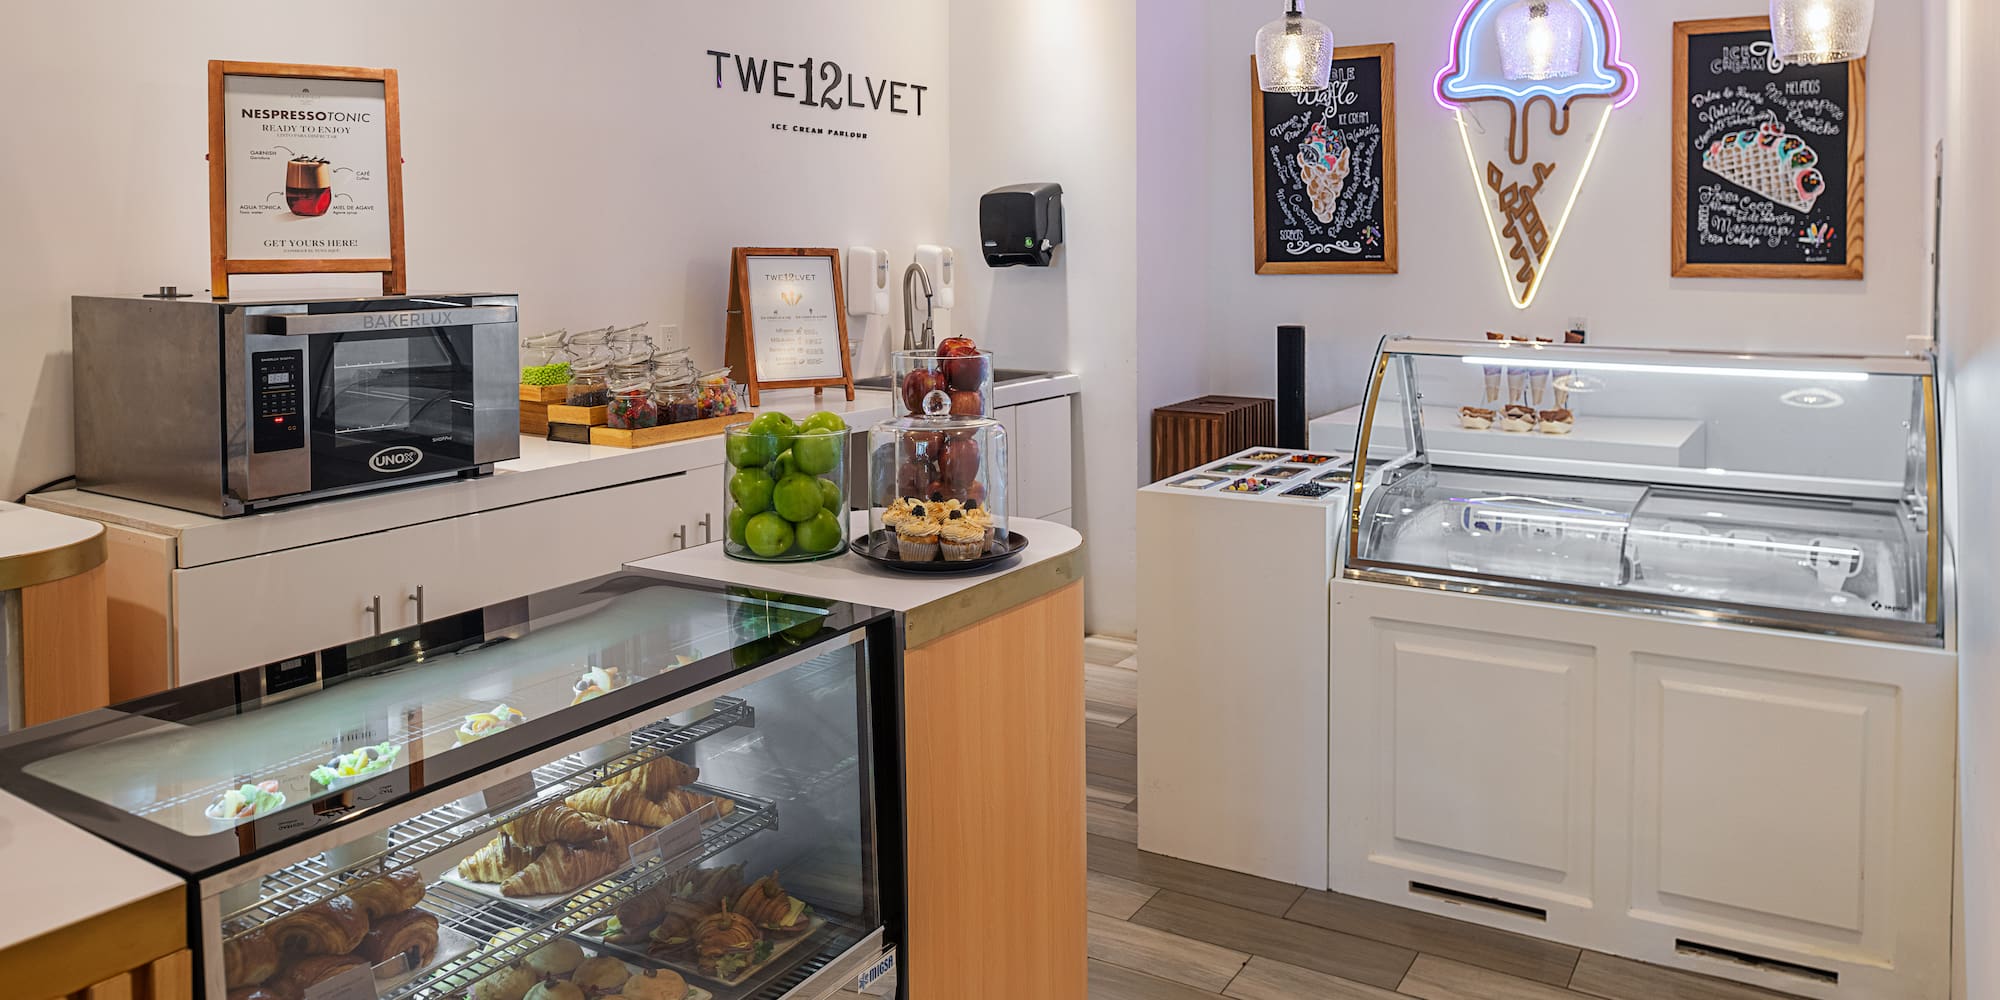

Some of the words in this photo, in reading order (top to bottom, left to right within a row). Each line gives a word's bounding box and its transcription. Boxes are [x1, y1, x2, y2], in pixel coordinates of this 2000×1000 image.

[1722, 46, 1750, 60] ICE
[1710, 57, 1765, 74] CREAM
[707, 50, 928, 116] TWE12LVET
[1292, 81, 1358, 118] Waffle
[1348, 111, 1369, 124] CREAM
[1698, 99, 1755, 122] Vainilla
[262, 124, 298, 133] READY
[300, 125, 316, 133] TO
[318, 125, 351, 134] ENJOY
[771, 123, 788, 131] ICE
[792, 126, 823, 134] CREAM
[828, 129, 868, 139] PARLOUR
[1270, 115, 1299, 137] Mango
[1346, 124, 1380, 143] Vainilla
[1740, 196, 1774, 212] Coco
[1289, 194, 1324, 235] Coconut
[263, 240, 285, 248] GET
[289, 240, 325, 248] YOURS
[327, 240, 359, 248] HERE!
[363, 312, 453, 329] BAKERLUX
[376, 452, 414, 467] UNOX
[869, 955, 893, 982] MIGSA
